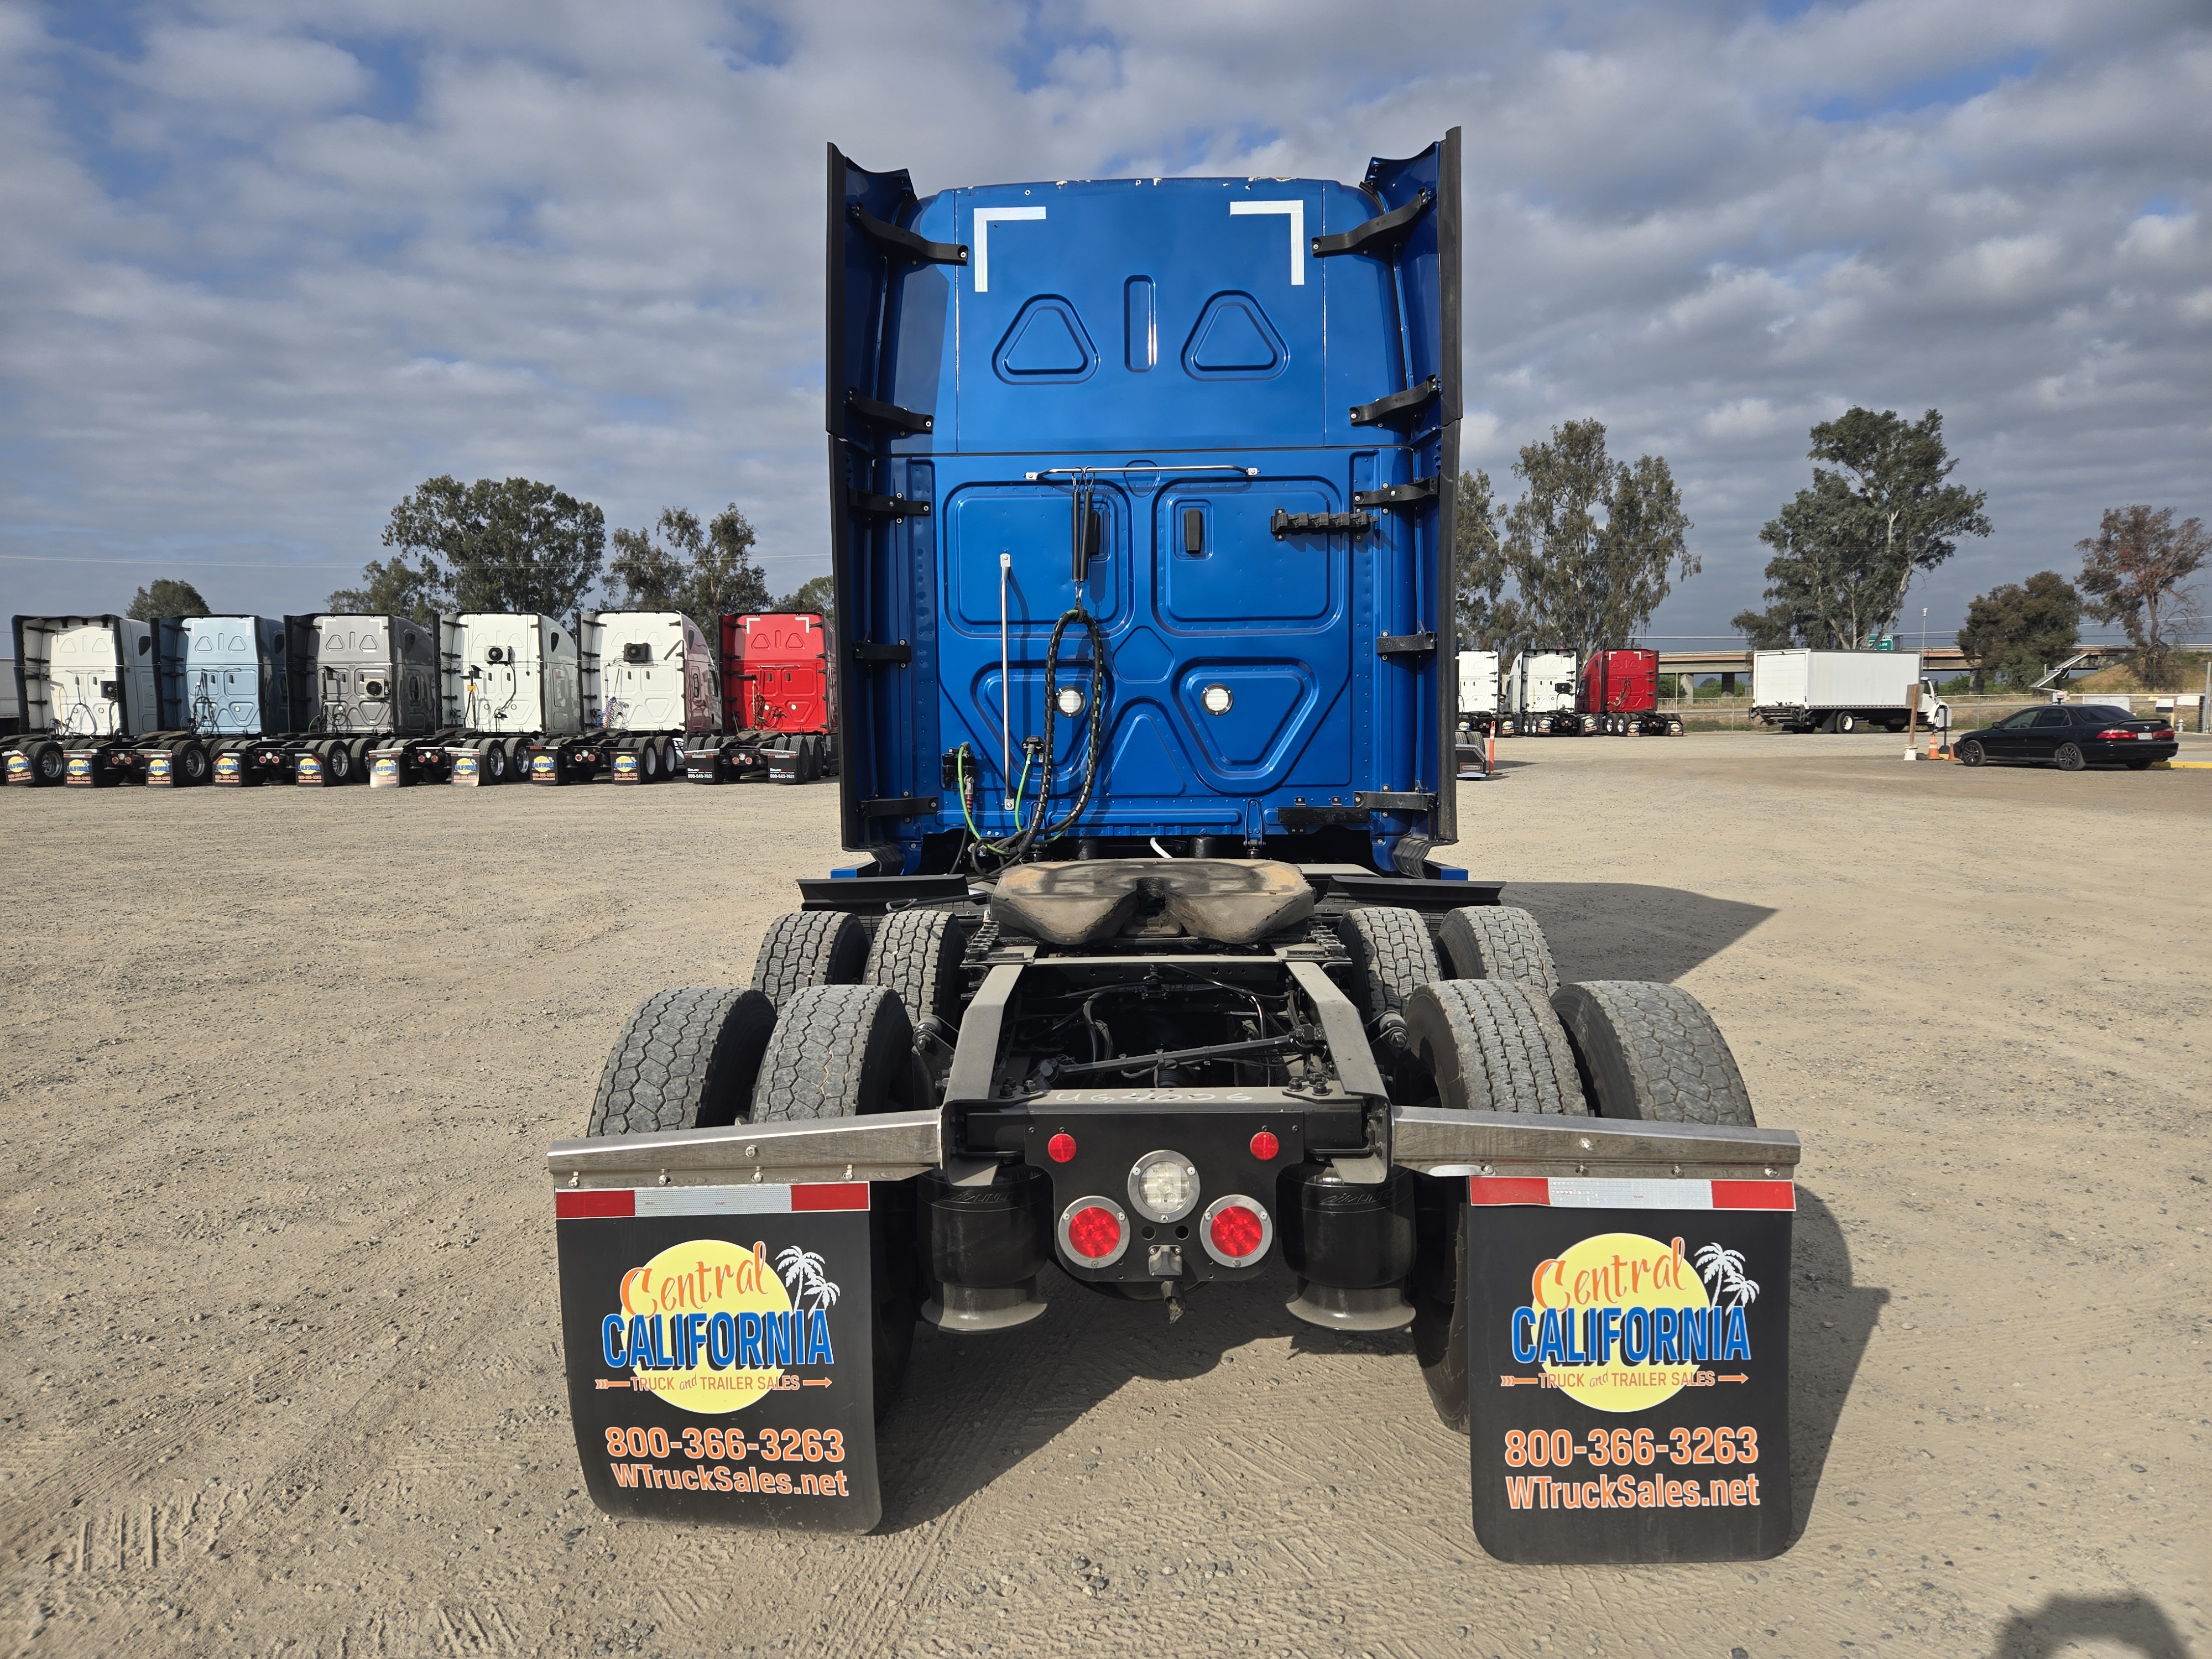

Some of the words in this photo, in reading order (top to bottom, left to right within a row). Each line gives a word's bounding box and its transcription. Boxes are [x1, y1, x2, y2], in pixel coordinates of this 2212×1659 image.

[620, 1240, 769, 1319] Central
[1532, 1236, 1687, 1313] Central
[602, 1308, 834, 1370] CALIFORNIA
[1511, 1305, 1752, 1366] CALIFORNIA
[630, 1376, 675, 1391] TRUCK
[679, 1373, 698, 1391] and
[699, 1375, 754, 1391] TRAILER
[757, 1375, 801, 1391] SALES
[1537, 1373, 1585, 1389] TRUCK
[1589, 1369, 1610, 1389] and
[1611, 1371, 1667, 1387] TRAILER
[1670, 1370, 1716, 1387] SALES
[604, 1426, 846, 1462] 800-366-3263
[1504, 1426, 1759, 1468] 800-366-3263
[610, 1462, 849, 1496] WTruckSales.net
[1505, 1472, 1761, 1510] WTruckSales.net
